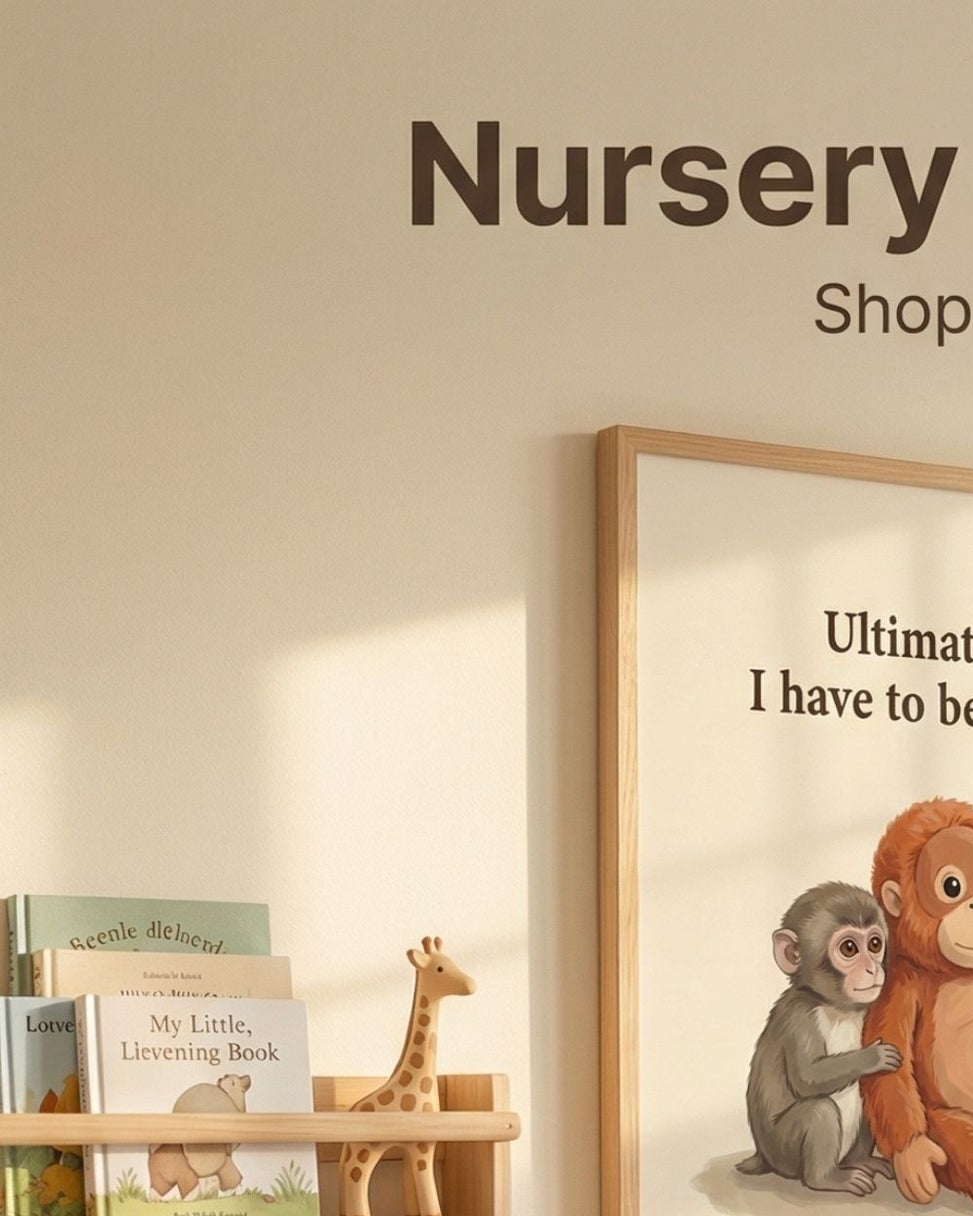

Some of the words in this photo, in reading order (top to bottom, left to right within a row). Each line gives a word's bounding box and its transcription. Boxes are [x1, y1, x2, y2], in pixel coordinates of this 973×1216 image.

[749, 668, 766, 712] I
[780, 668, 873, 719] have
[886, 683, 925, 723] to
[149, 1014, 182, 1039] My
[190, 1014, 252, 1037] Little,
[228, 1042, 281, 1061] Book
